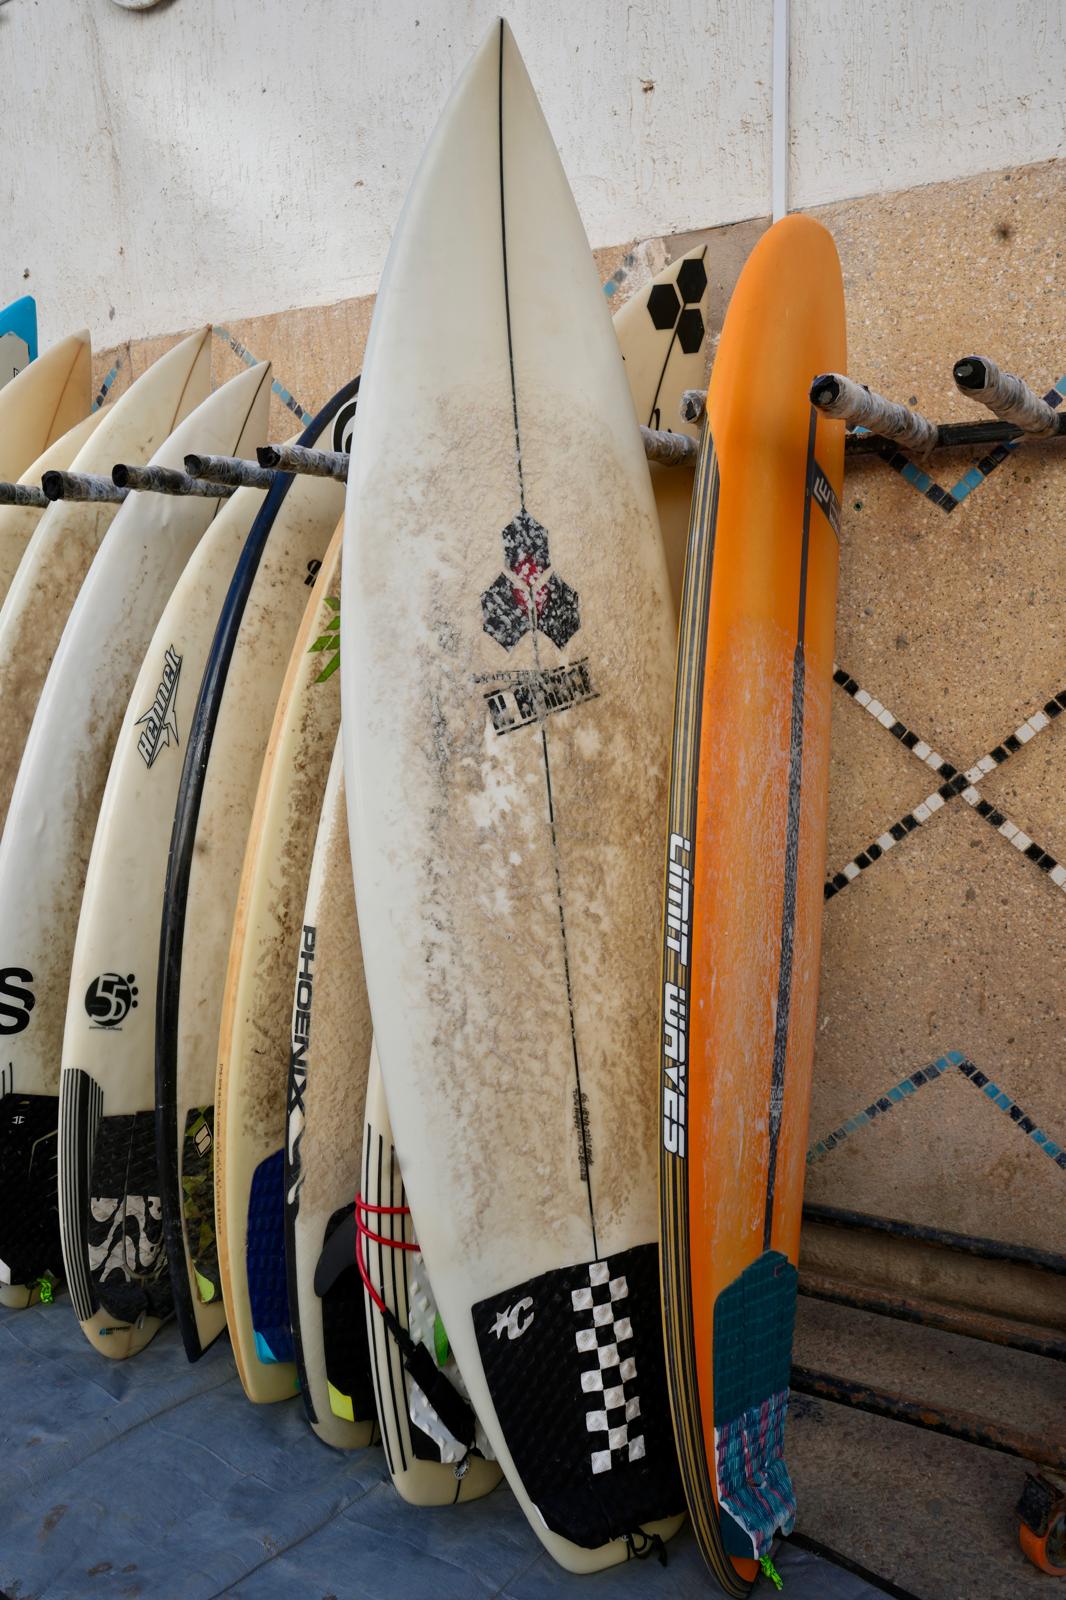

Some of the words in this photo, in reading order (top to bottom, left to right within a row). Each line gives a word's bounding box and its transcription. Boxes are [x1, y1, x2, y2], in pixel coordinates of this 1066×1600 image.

[667, 832, 691, 966] LIMIT
[91, 974, 128, 1023] 55
[287, 925, 316, 1109] PHOENIX
[663, 982, 686, 1159] WAVES
